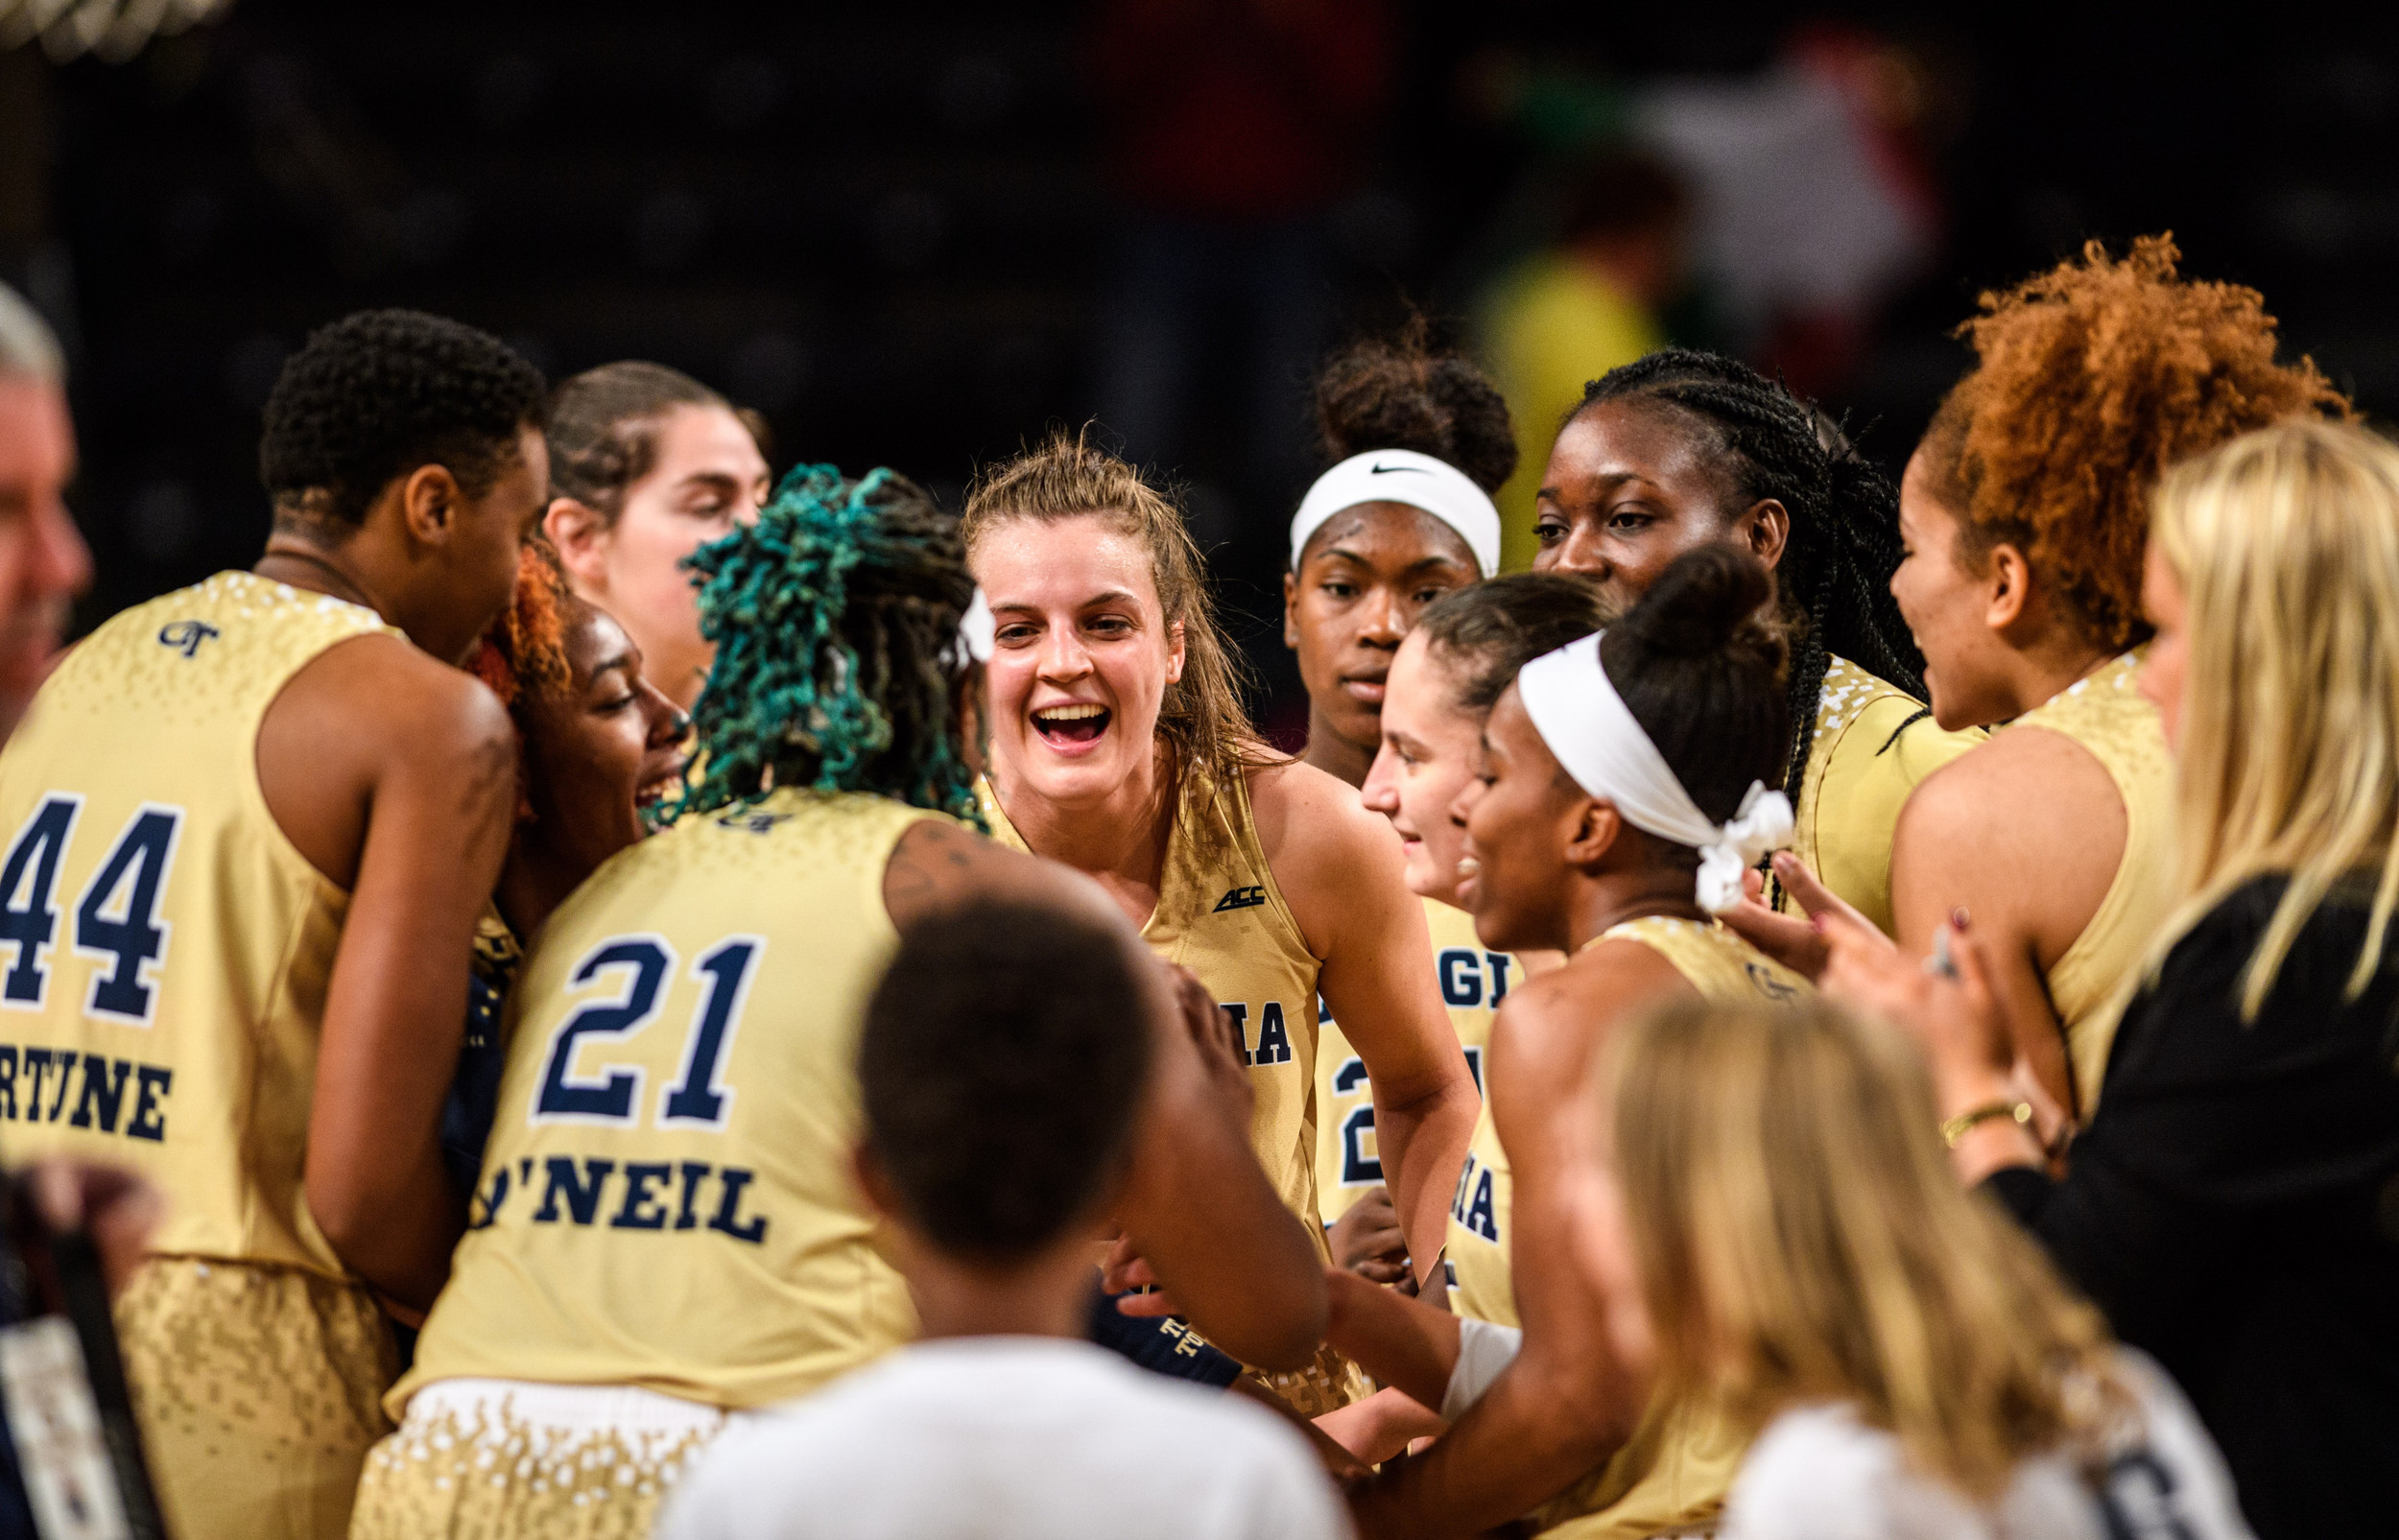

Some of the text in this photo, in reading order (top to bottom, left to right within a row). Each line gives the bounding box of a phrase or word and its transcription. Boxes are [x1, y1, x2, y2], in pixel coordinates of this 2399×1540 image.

[0, 789, 186, 1030] 44
[1212, 886, 1265, 913] ACC
[527, 933, 769, 1134] 21
